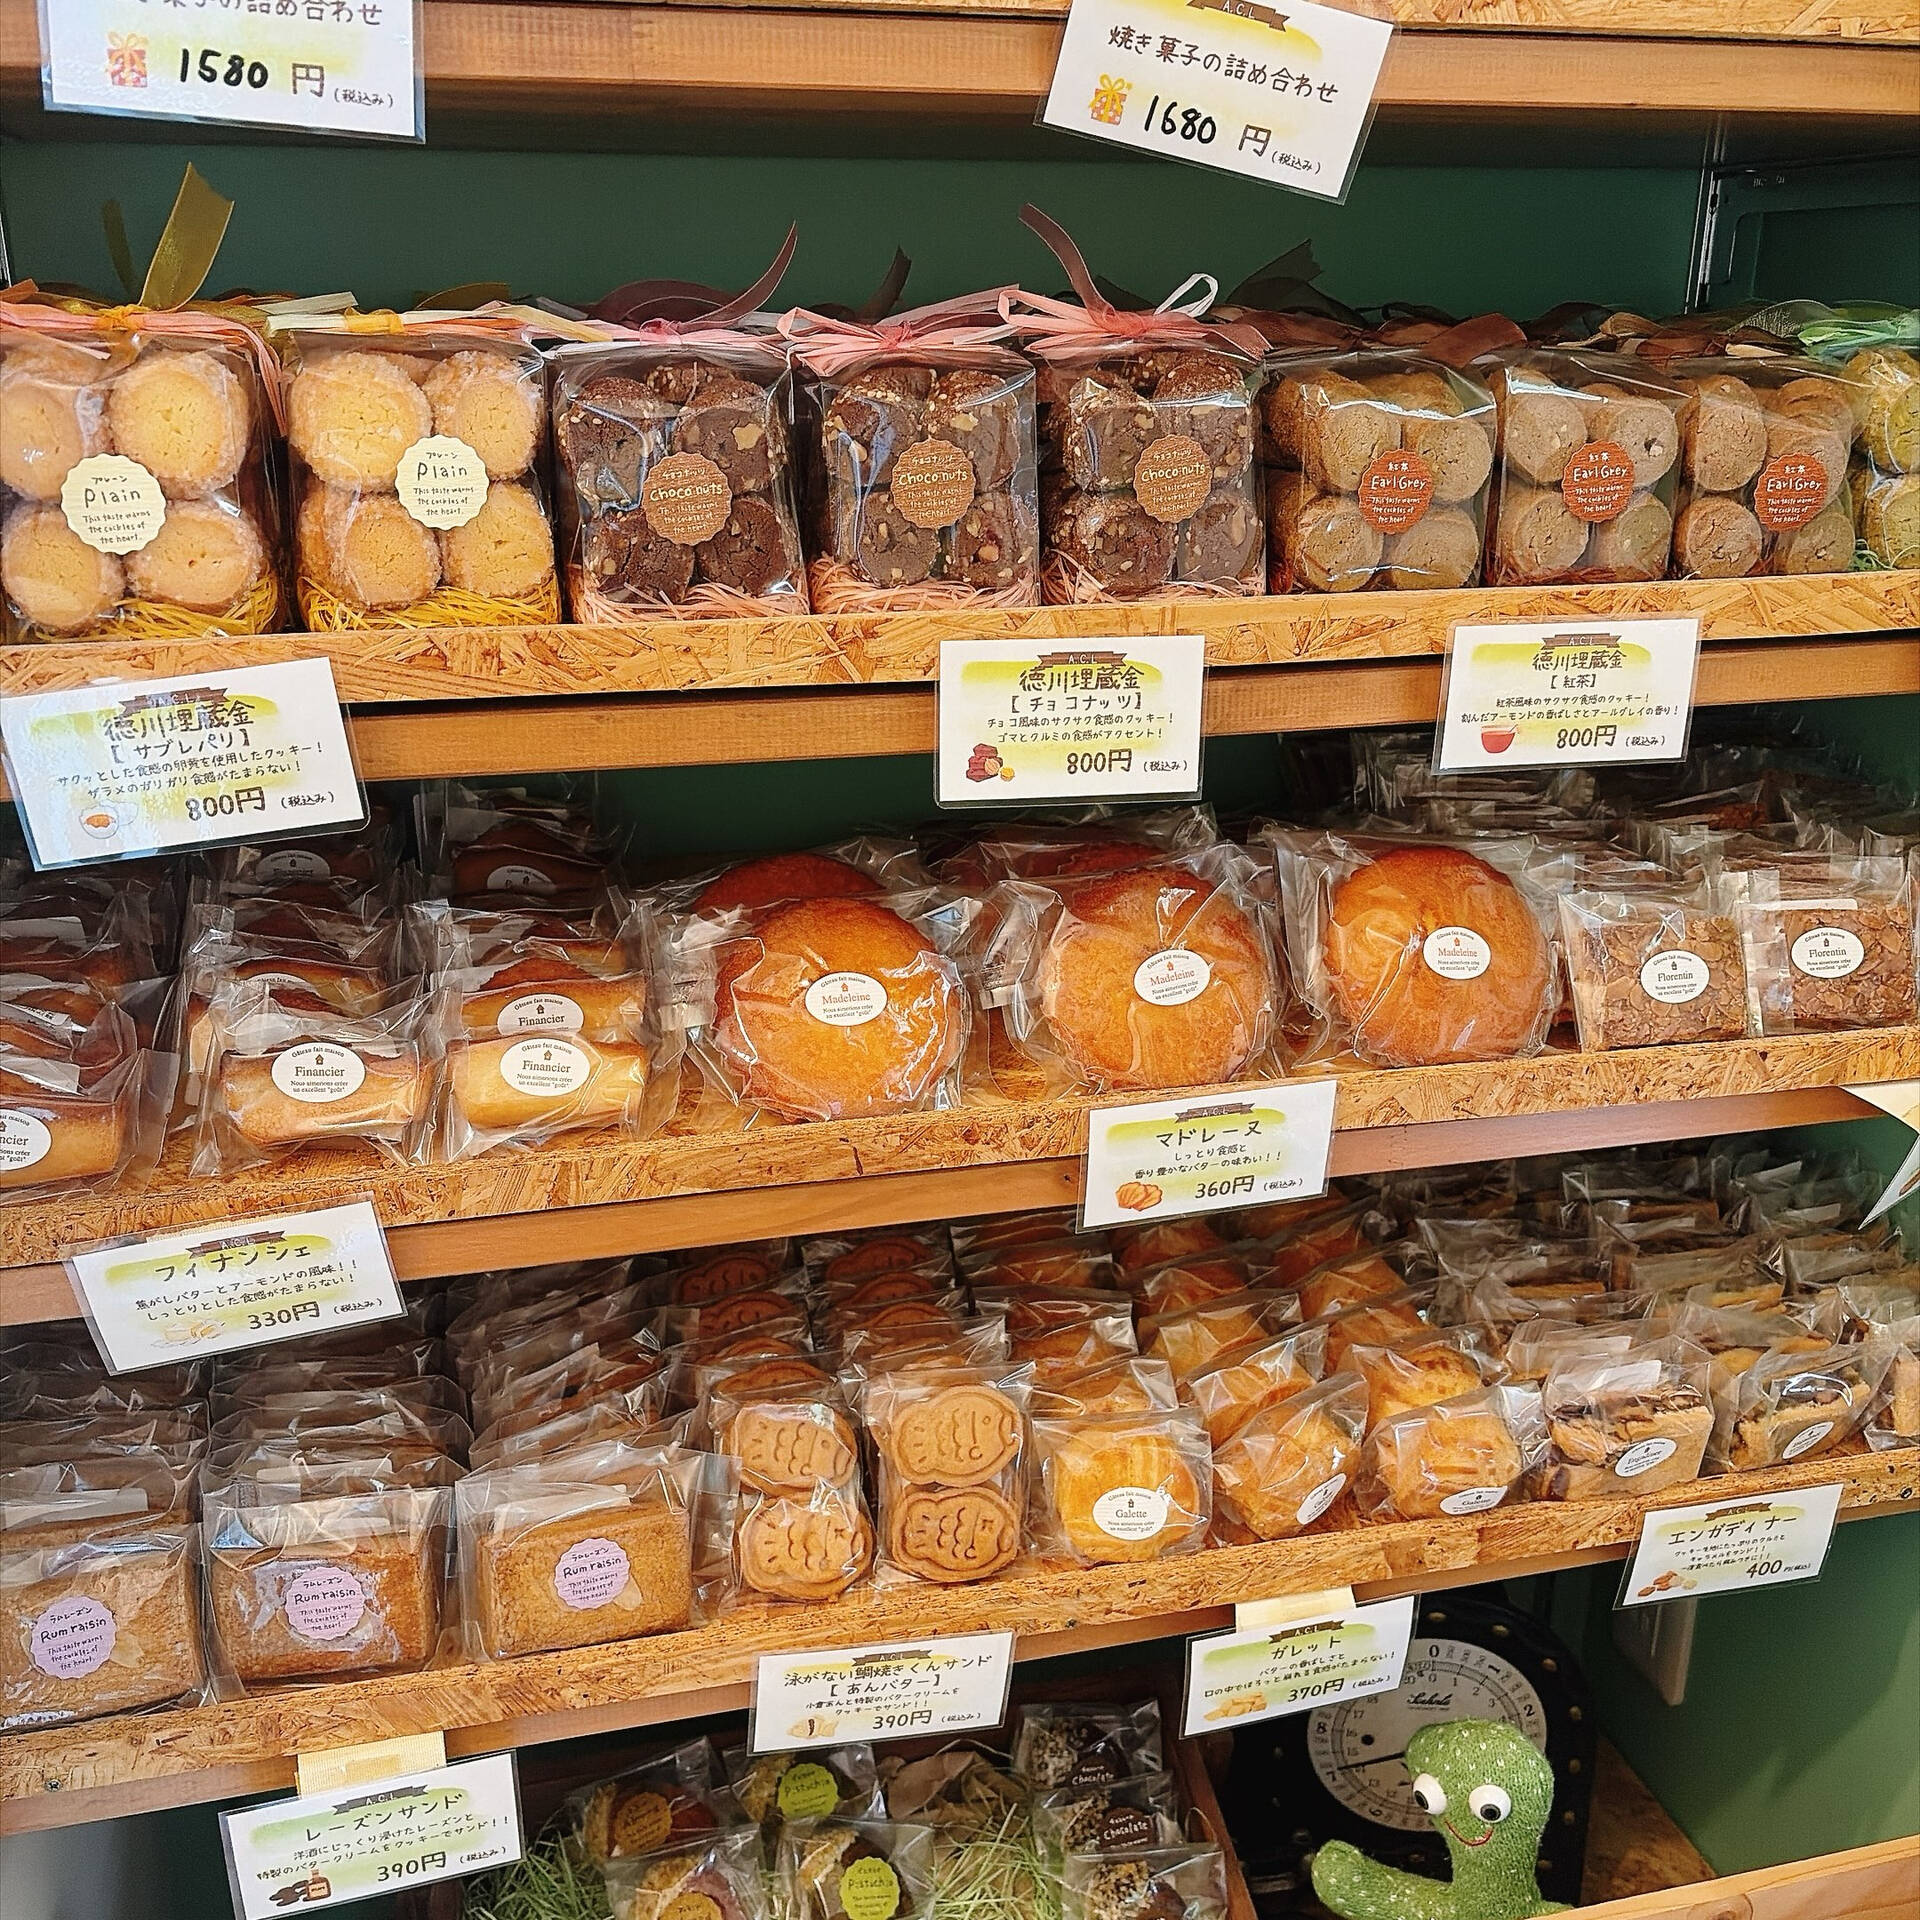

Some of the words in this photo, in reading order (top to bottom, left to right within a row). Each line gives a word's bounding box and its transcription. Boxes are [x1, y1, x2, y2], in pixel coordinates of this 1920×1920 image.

[180, 48, 269, 89] 1580
[291, 62, 325, 98] 円
[1108, 26, 1339, 104] 焼き菓子の詰め合わせ
[1144, 95, 1217, 144] 1680
[1238, 124, 1272, 157] 円
[417, 462, 467, 481] Plain
[1371, 475, 1396, 490] Earl
[1398, 476, 1426, 490] Grey
[1573, 466, 1598, 482] Earl
[1601, 465, 1627, 479] Grey
[1767, 478, 1793, 492] Earl
[1795, 478, 1821, 491] Grey
[84, 488, 141, 508] Plain
[1532, 650, 1627, 672] 徳川埋蔵金
[1019, 665, 1145, 693] 徳川埋蔵金
[1550, 673, 1596, 689] 【紅茶】
[101, 701, 256, 743] 徳川埋蔵金
[1557, 725, 1617, 749] 800円
[1066, 748, 1132, 774] 800円
[185, 785, 266, 821] 800円
[518, 1015, 565, 1026] Financier
[295, 1066, 345, 1077] Financier
[522, 1060, 571, 1073] Financier
[1156, 1120, 1262, 1147] マドレーヌ
[1195, 1174, 1255, 1199] 360円
[155, 1245, 311, 1282] フィナンシェ
[248, 1301, 320, 1330] 330円
[1668, 1515, 1797, 1545] エンガディナー
[563, 1567, 587, 1579] Rum
[1746, 1560, 1782, 1578] 400
[294, 1594, 320, 1605] Rum
[41, 1628, 68, 1643] Rum
[70, 1618, 107, 1633] raisin
[1272, 1636, 1341, 1660] ガレット
[1429, 1645, 1440, 1657] 0
[784, 1655, 992, 1687] 泳がない鯛焼きくんサンド
[1288, 1678, 1345, 1702] 370円
[873, 1709, 932, 1730] 390円
[1524, 1703, 1535, 1717] 2
[306, 1794, 462, 1841] レーズンサンド
[377, 1851, 446, 1882] 390円
